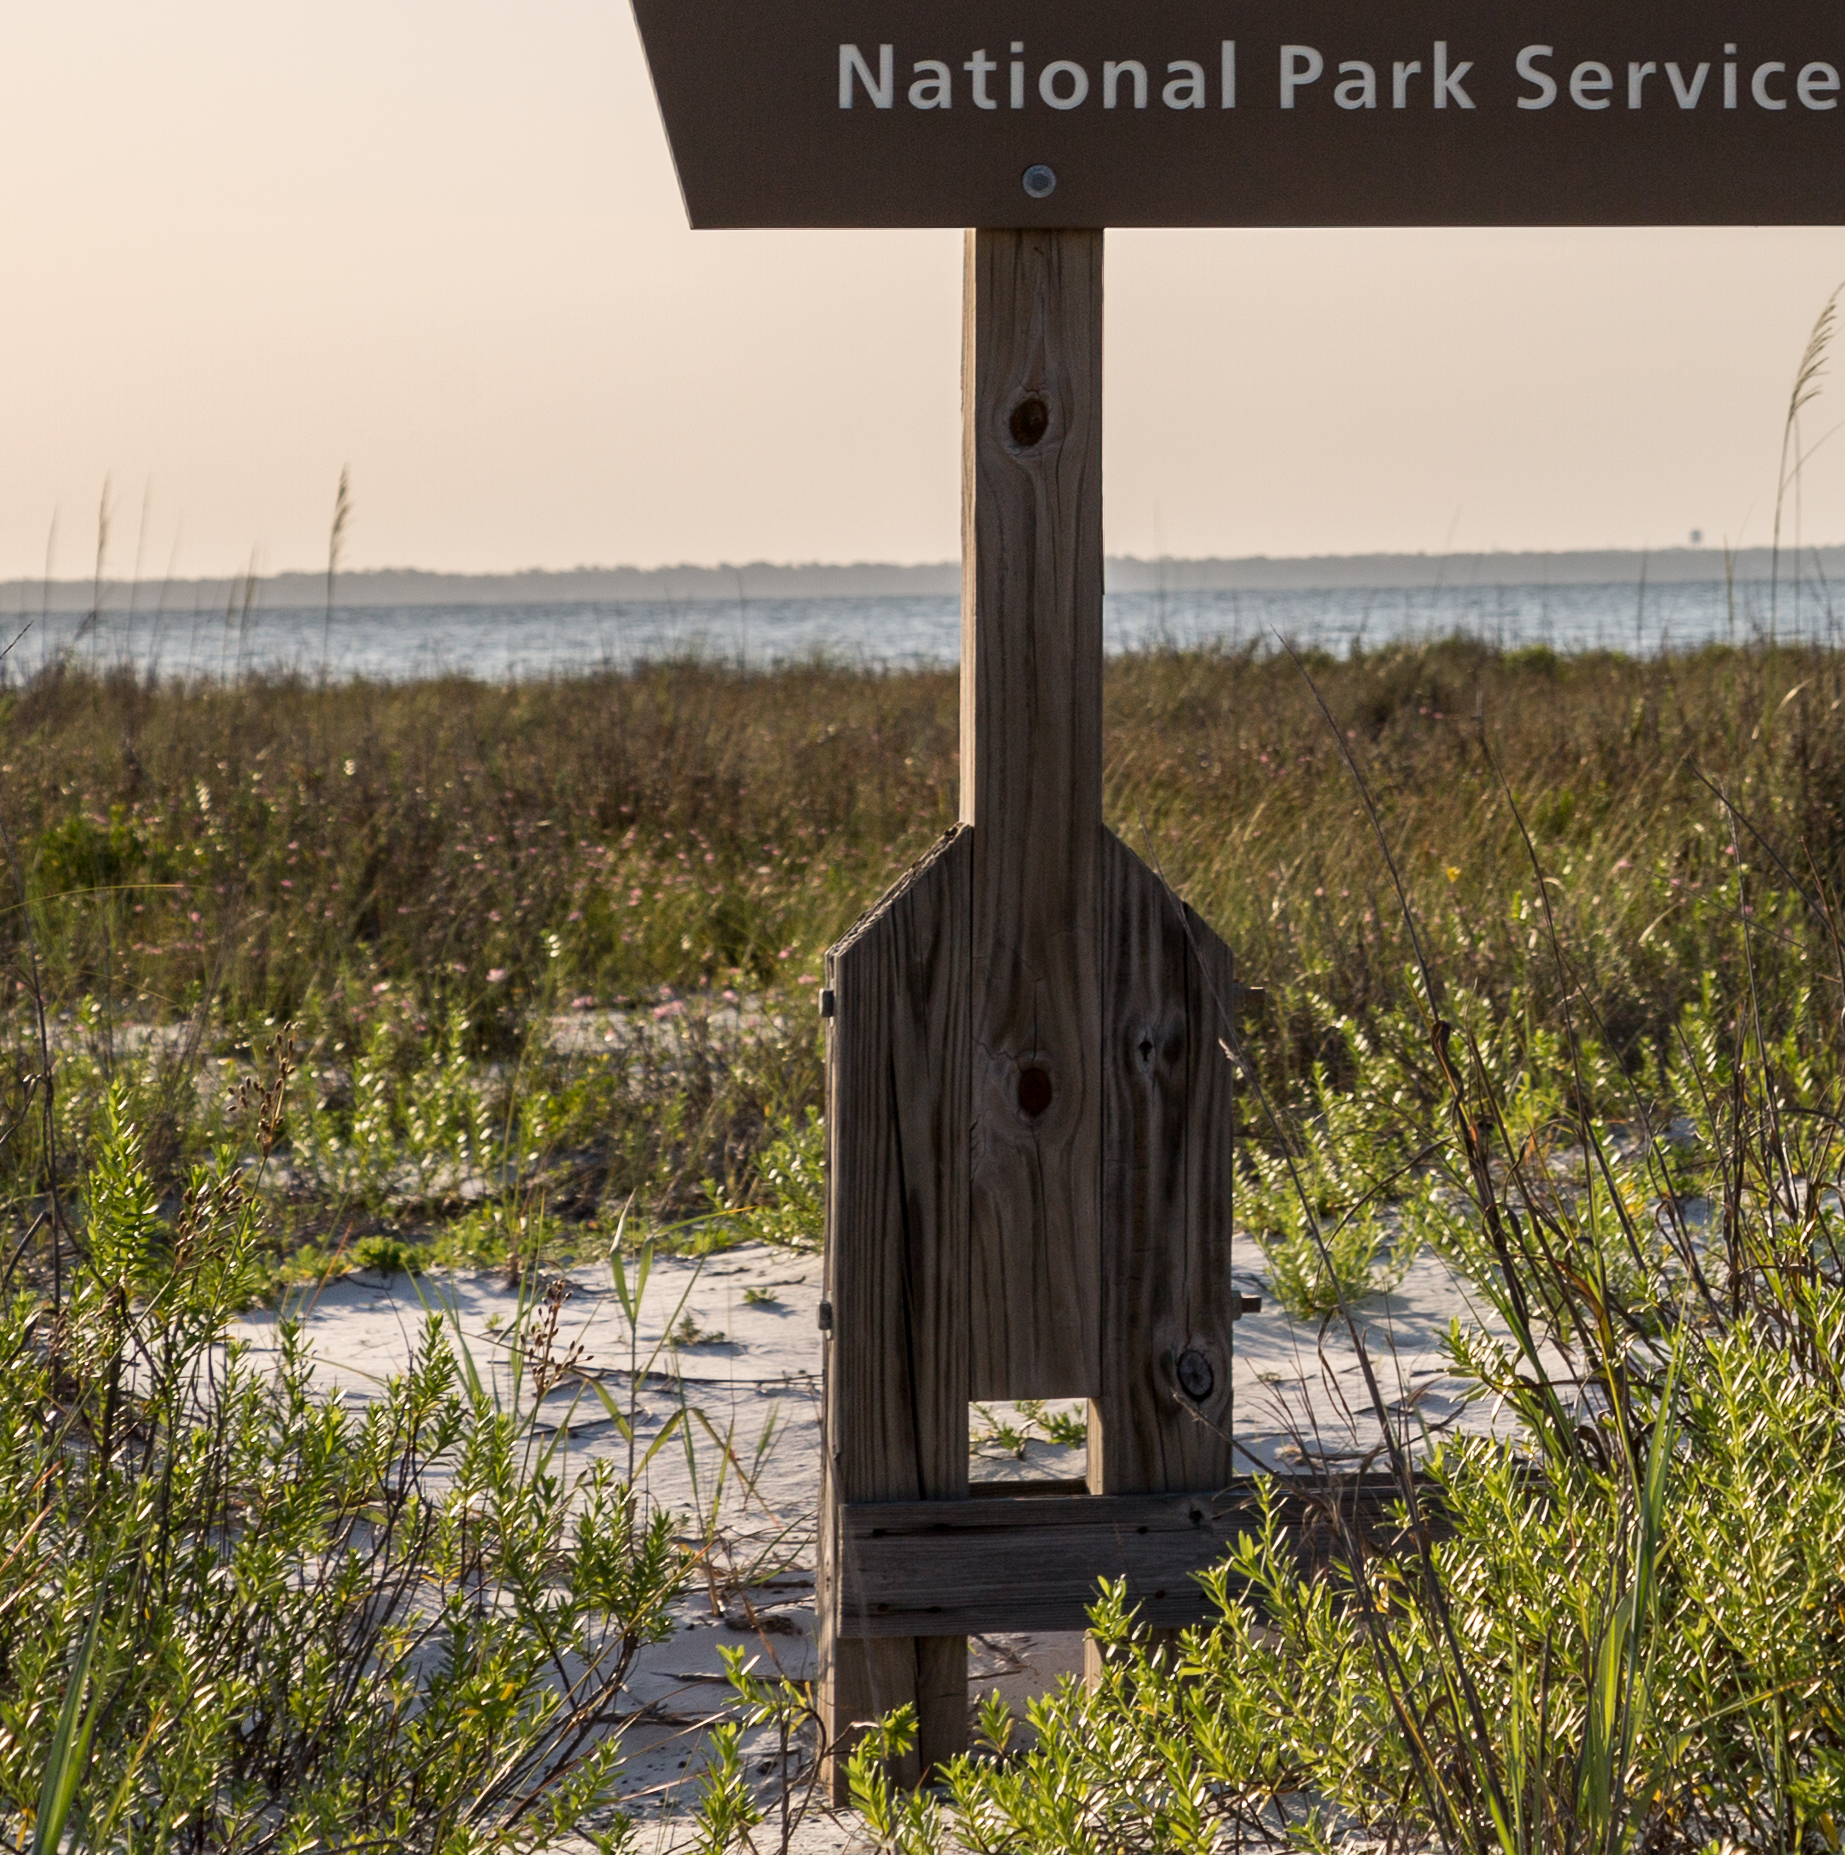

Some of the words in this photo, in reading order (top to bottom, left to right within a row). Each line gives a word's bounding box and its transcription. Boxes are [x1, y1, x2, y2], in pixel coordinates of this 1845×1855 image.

[839, 41, 1235, 110] National
[1280, 41, 1475, 110] Park
[1516, 43, 1840, 111] Service
